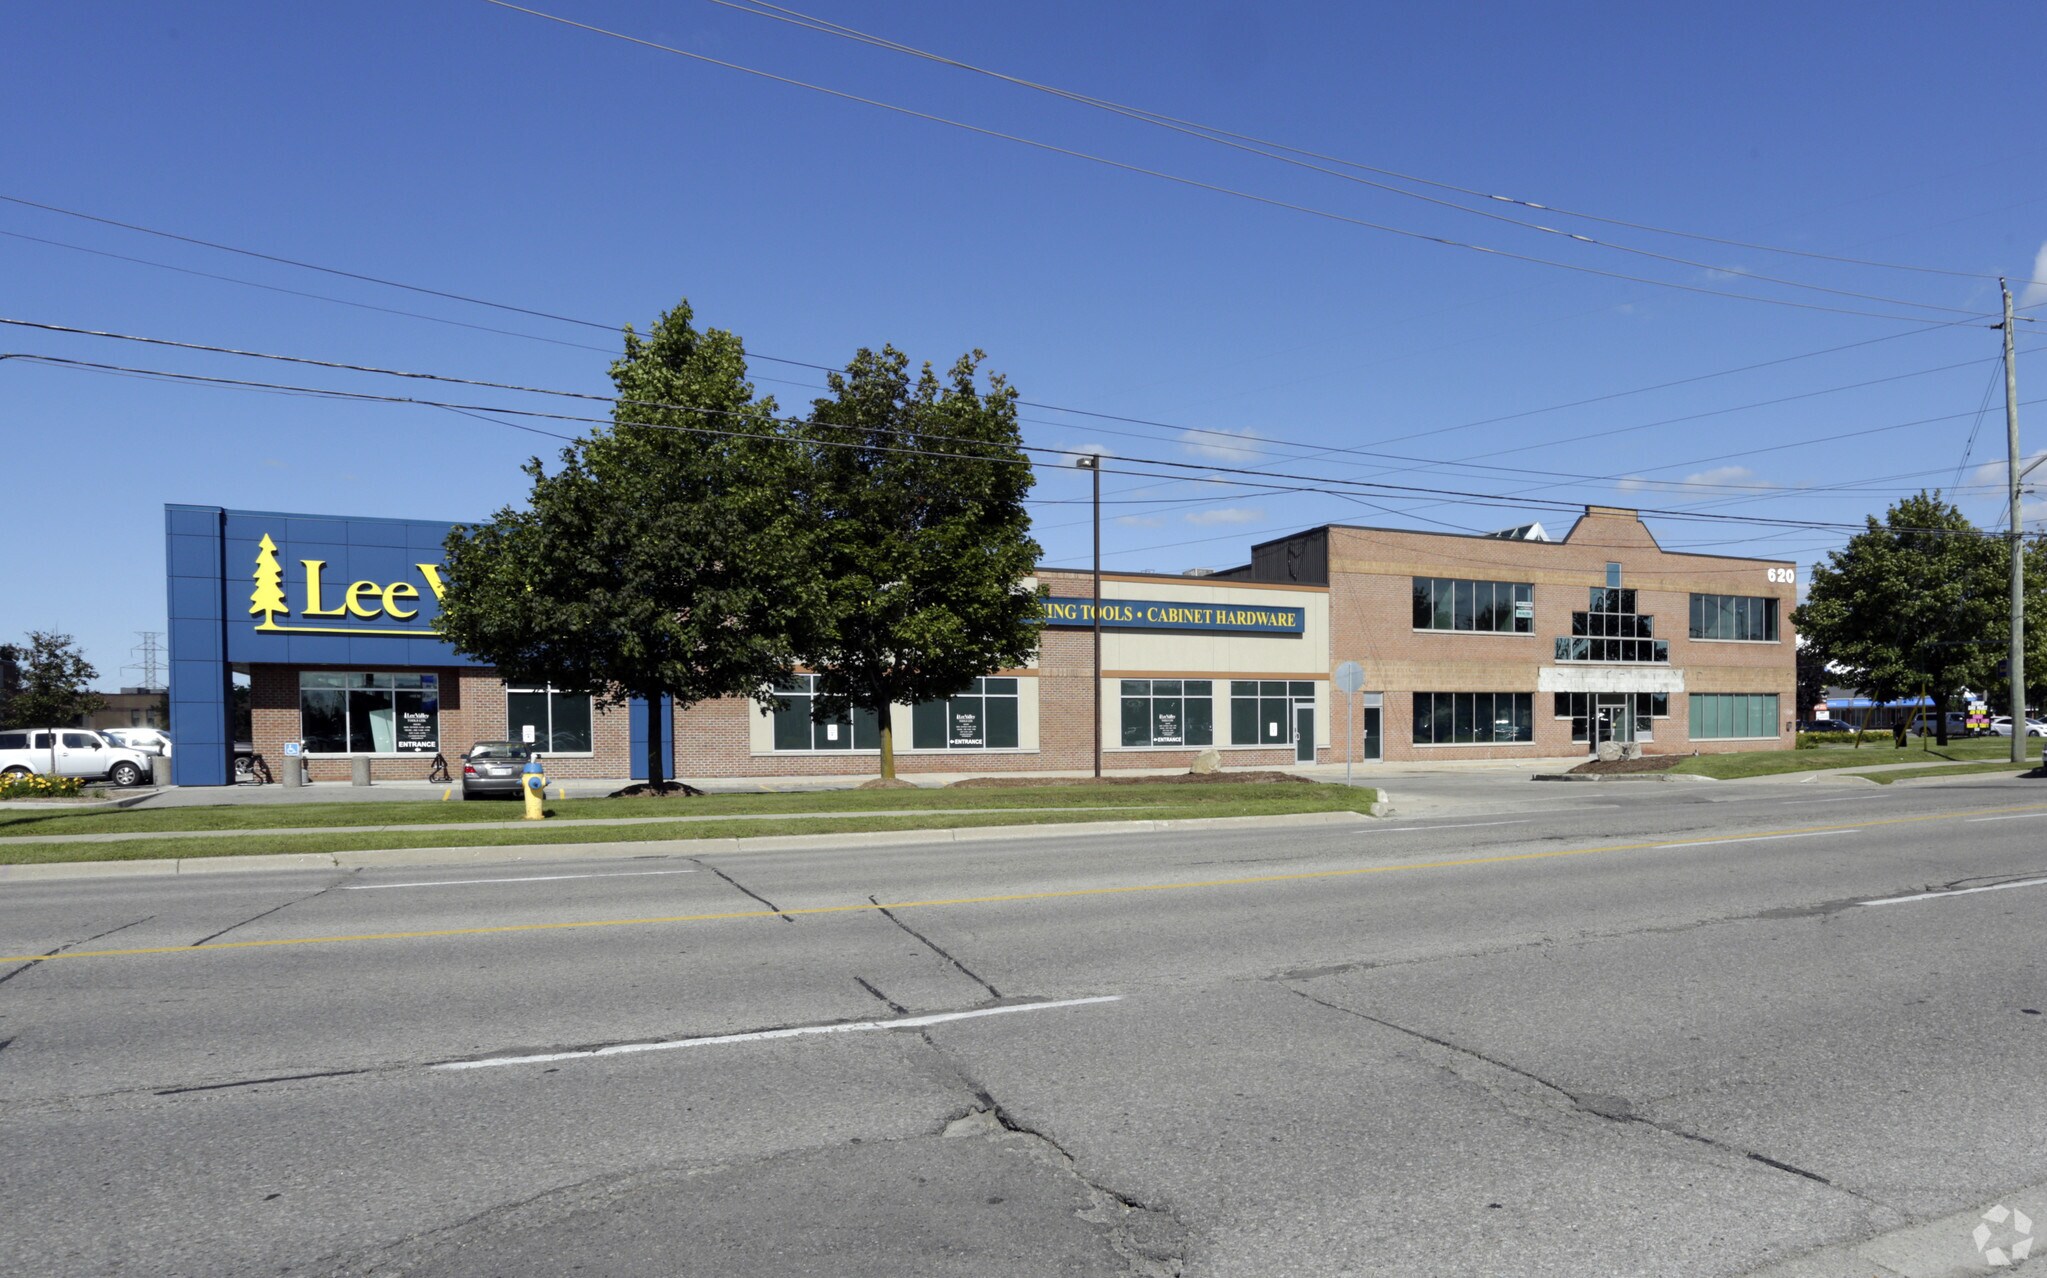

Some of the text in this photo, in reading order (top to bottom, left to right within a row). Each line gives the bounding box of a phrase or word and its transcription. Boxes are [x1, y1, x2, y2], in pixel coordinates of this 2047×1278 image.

[1767, 568, 1795, 584] 620
[300, 559, 420, 618] Lee
[1080, 604, 1133, 621] TOOLS
[1147, 607, 1213, 624] CABINET
[1215, 610, 1296, 627] HARDWARE
